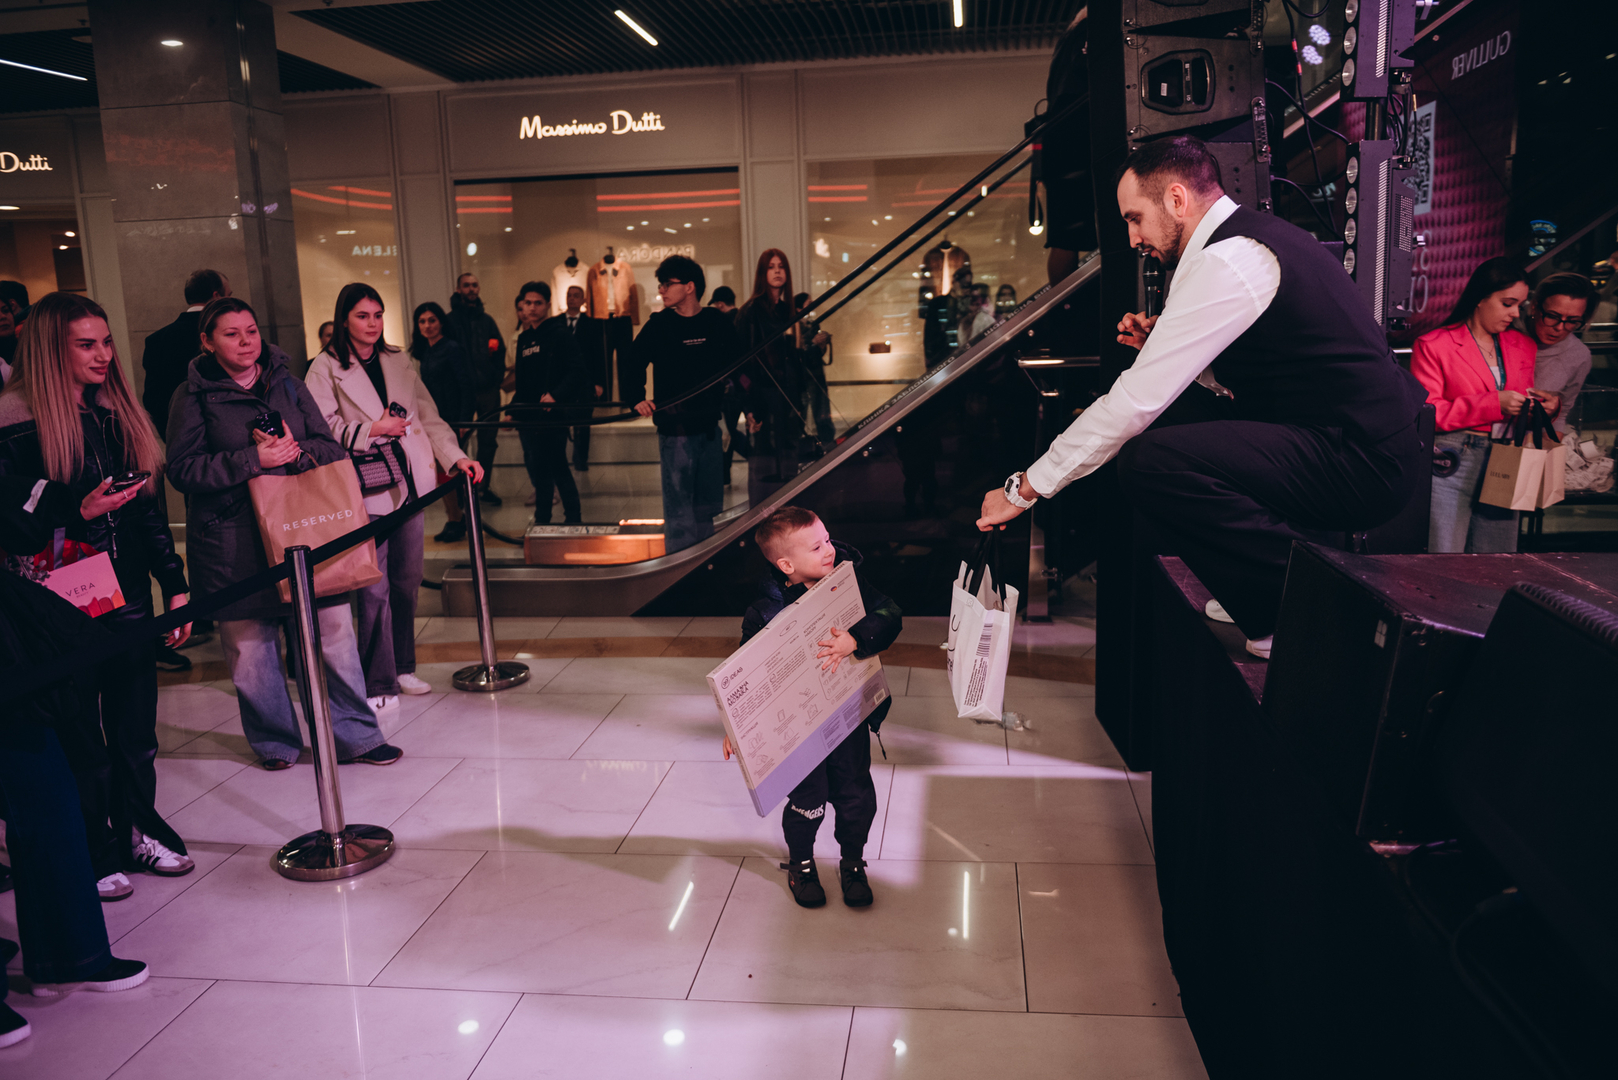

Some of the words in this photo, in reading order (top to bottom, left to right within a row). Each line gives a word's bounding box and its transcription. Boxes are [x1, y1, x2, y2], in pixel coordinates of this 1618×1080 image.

[519, 115, 607, 139] Massimo
[610, 110, 665, 135] Dutti
[0, 151, 53, 173] Dutti
[891, 356, 955, 405] ЗАБЛОЦЬКОГО
[283, 509, 353, 531] RESERVED
[65, 582, 96, 597] VERA
[730, 667, 743, 680] IDEAS
